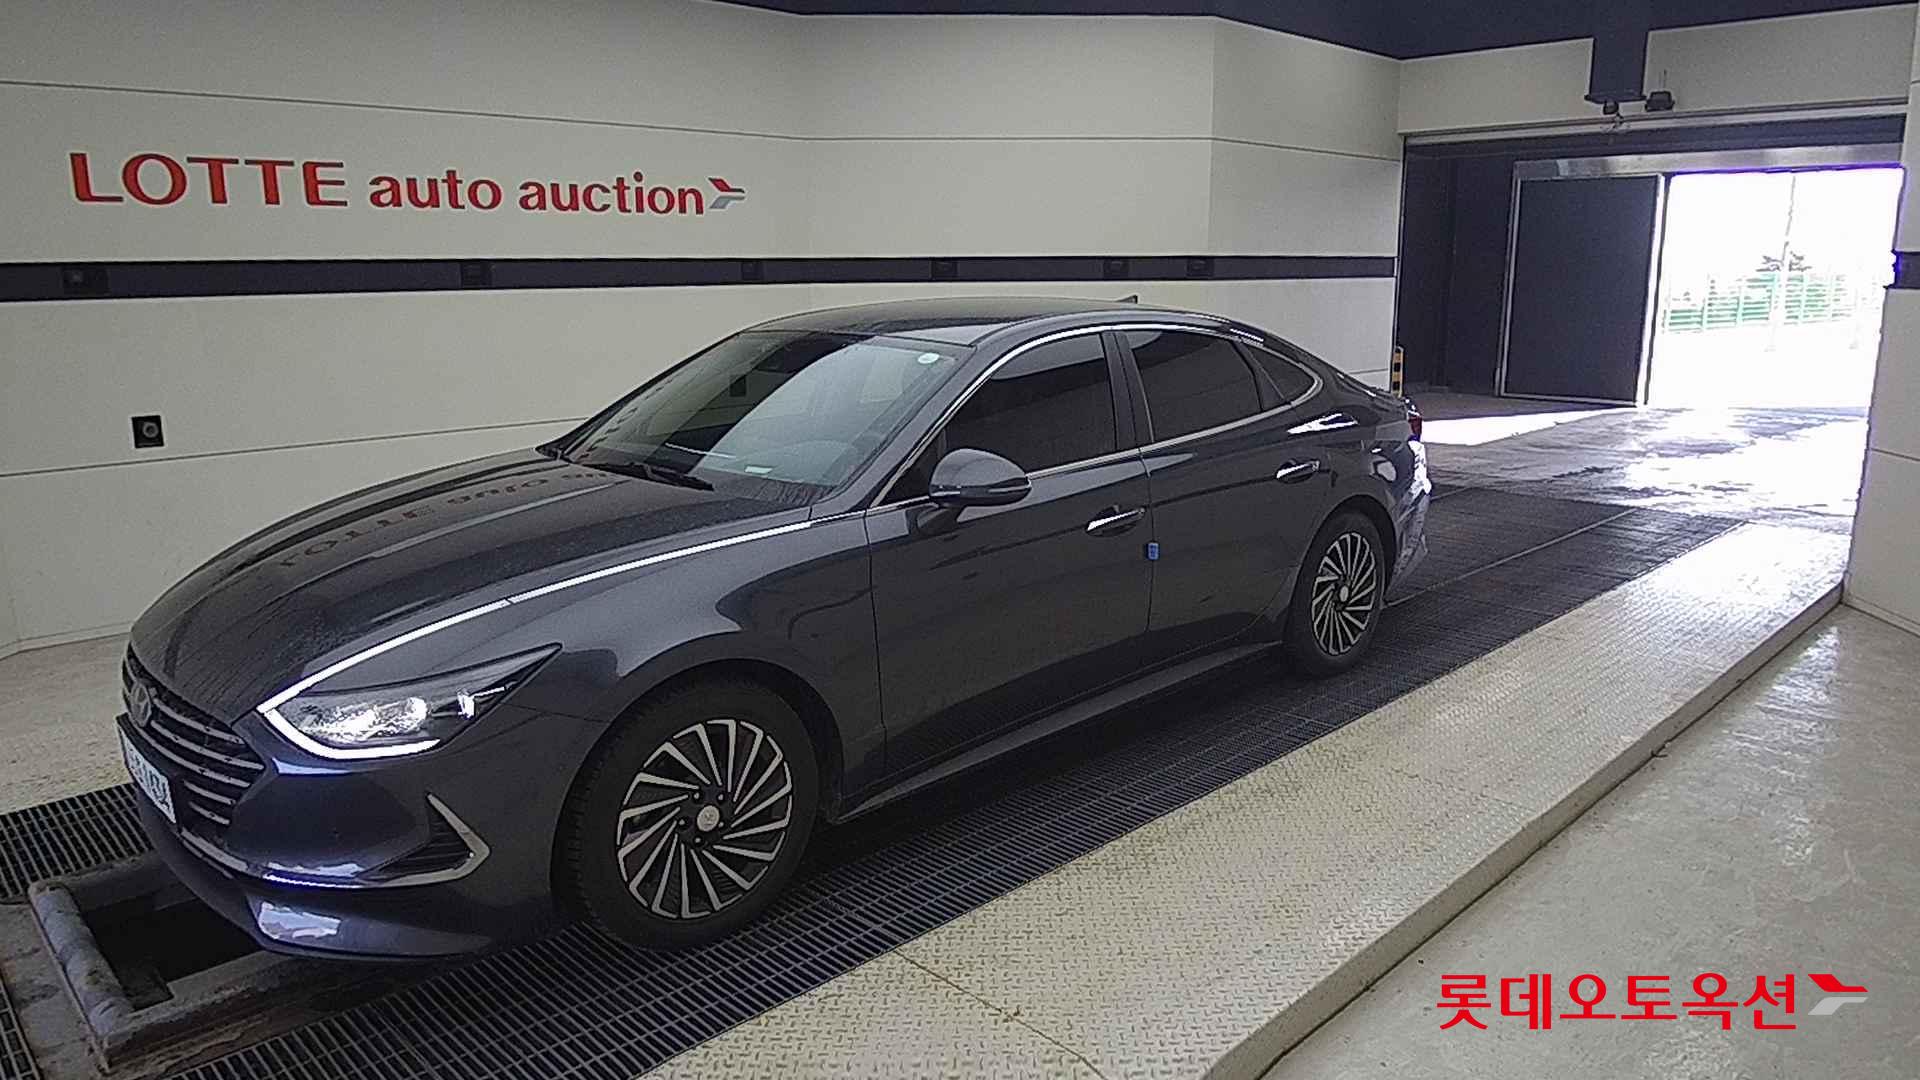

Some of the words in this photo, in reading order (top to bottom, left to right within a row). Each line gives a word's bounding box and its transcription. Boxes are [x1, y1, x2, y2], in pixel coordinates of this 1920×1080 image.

[70, 152, 348, 208] LOTTE
[369, 169, 503, 210] auto
[519, 171, 705, 215] auction
